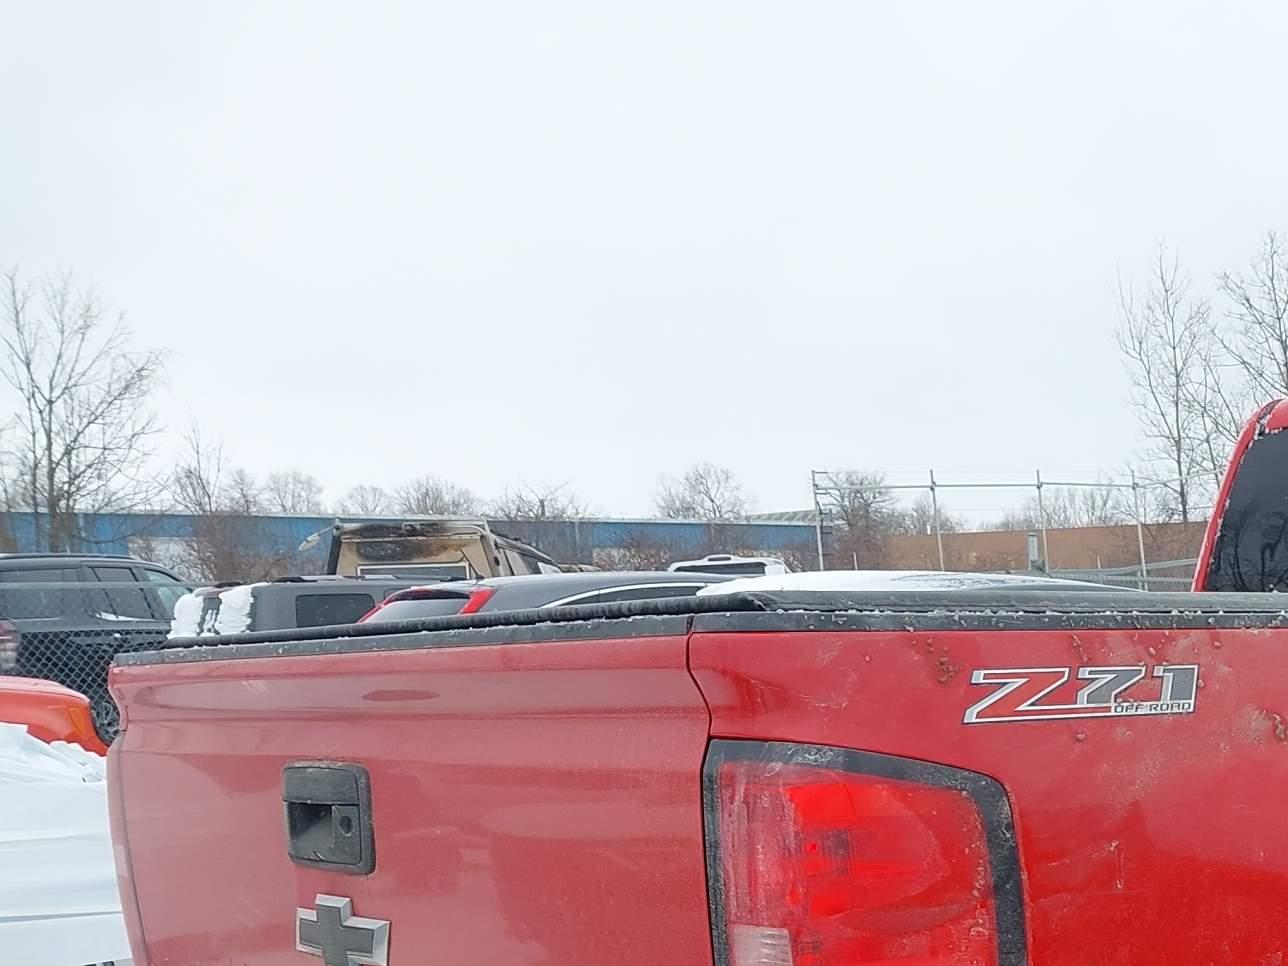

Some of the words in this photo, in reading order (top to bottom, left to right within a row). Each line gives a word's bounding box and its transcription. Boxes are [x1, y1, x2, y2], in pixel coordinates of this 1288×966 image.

[962, 664, 1200, 725] Z71
[1113, 702, 1145, 715] OFF
[1148, 701, 1193, 713] ROAD
